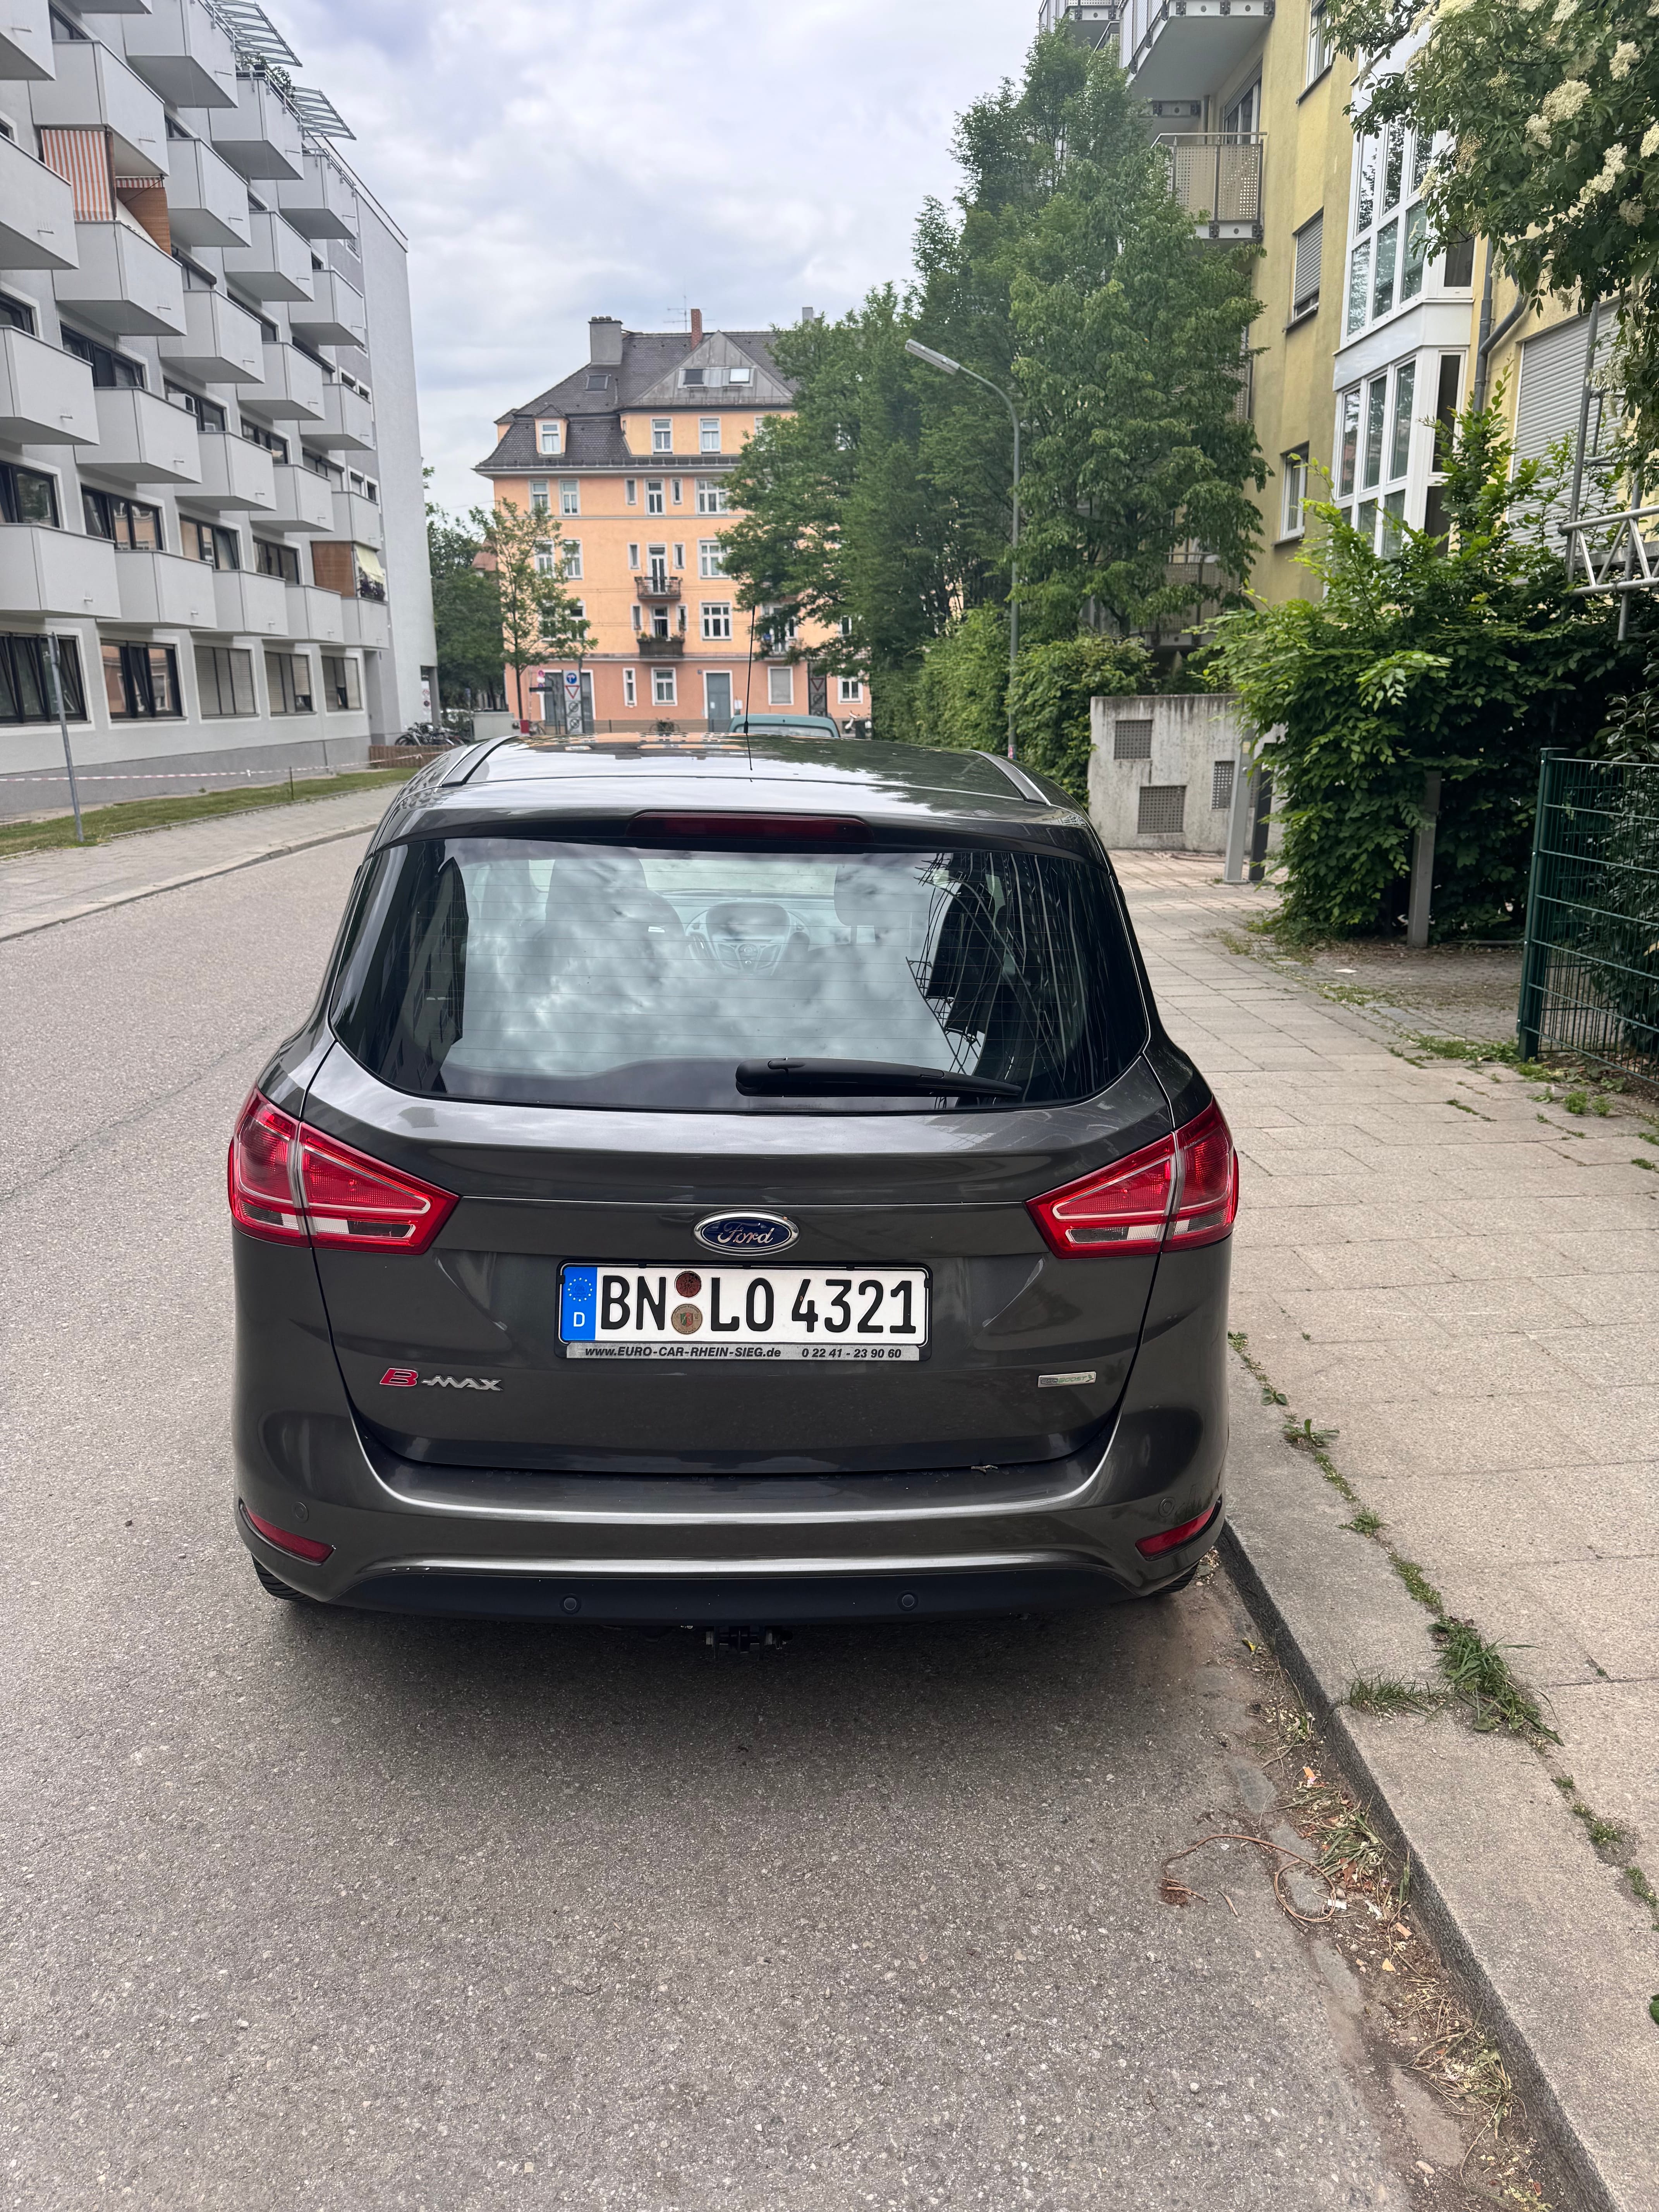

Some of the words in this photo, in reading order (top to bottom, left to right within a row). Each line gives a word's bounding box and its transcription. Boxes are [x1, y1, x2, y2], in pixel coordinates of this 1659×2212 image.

[718, 1221, 775, 1243] Ford
[600, 1275, 666, 1330] BN
[710, 1277, 775, 1332] LO
[791, 1278, 917, 1334] 4321
[574, 1312, 585, 1327] D
[585, 1346, 781, 1357] www.EURO-CAR-RHEIN-SIEG.de
[802, 1348, 809, 1357] 0
[812, 1348, 826, 1357] 22
[829, 1349, 842, 1357] 41
[854, 1349, 868, 1358] 23
[871, 1349, 884, 1358] 90
[888, 1349, 902, 1358] 60
[380, 1368, 503, 1391] B-MAX
